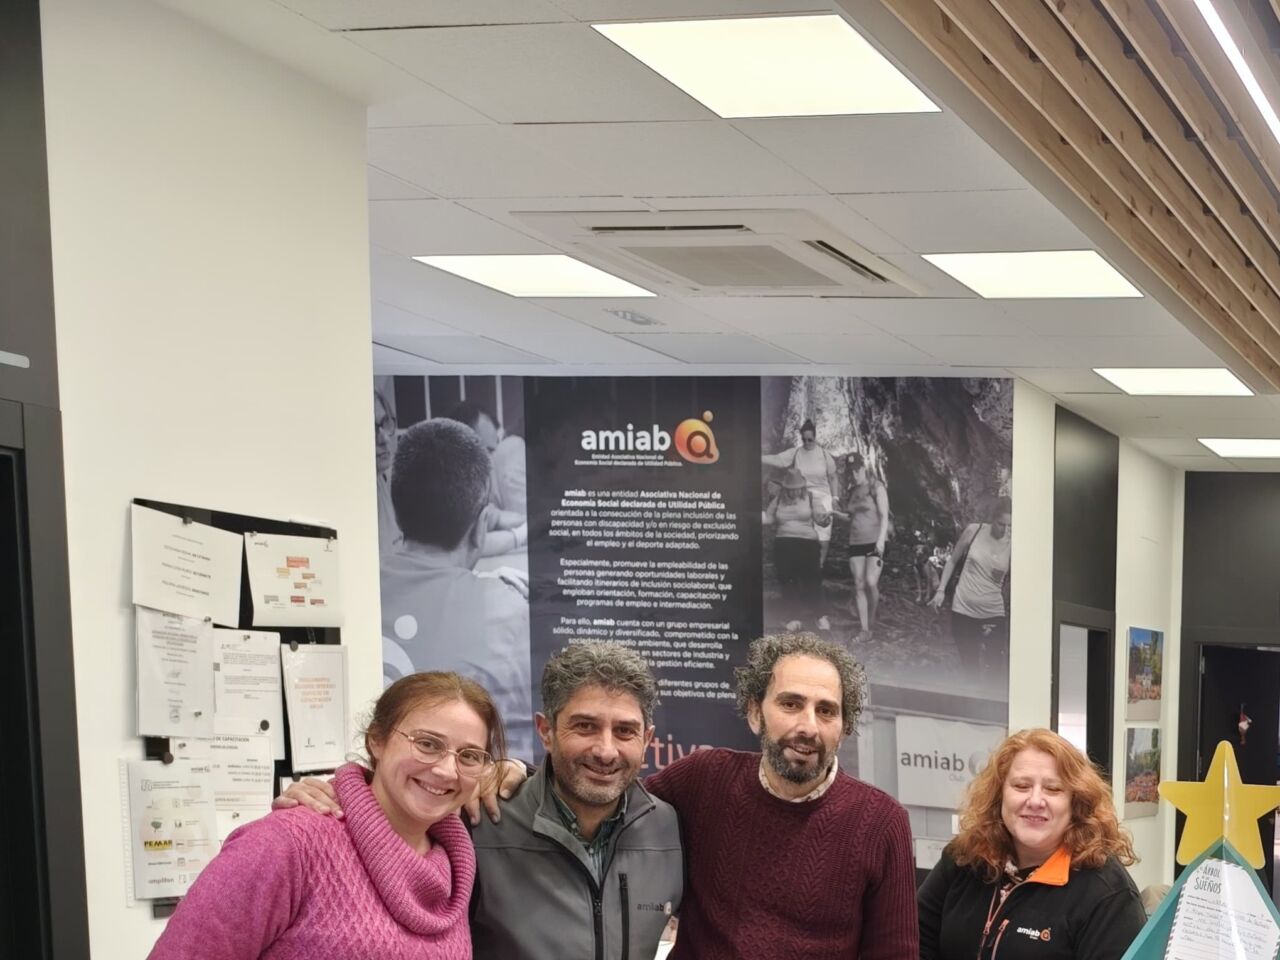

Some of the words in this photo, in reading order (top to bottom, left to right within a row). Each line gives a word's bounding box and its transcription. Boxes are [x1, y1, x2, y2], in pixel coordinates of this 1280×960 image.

[581, 423, 671, 451] amiab
[565, 488, 586, 496] amiab
[612, 489, 638, 497] entidad
[678, 490, 710, 498] Nacional
[562, 498, 596, 506] Economía
[597, 499, 619, 507] Social
[668, 500, 696, 508] Utilidad
[698, 500, 725, 508] Pública
[662, 510, 681, 520] plena
[726, 511, 736, 519] las
[552, 520, 582, 528] personas
[646, 520, 657, 530] y/o
[669, 520, 691, 530] riesgo
[549, 528, 570, 538] social,
[582, 528, 602, 536] todos
[603, 529, 613, 537] los
[615, 529, 643, 537] ámbitos
[594, 538, 620, 549] empleo
[636, 539, 663, 550] deporte
[612, 561, 648, 569] promueve
[718, 561, 728, 569] las
[564, 570, 595, 578] personas
[563, 587, 595, 598] engloban
[717, 584, 732, 592] que
[625, 599, 652, 609] empleo
[561, 616, 576, 624] Para
[578, 617, 591, 627] ello,
[593, 617, 615, 626] amiab
[616, 618, 640, 626] cuenta
[666, 622, 687, 630] grupo
[553, 626, 575, 636] sólido,
[576, 626, 608, 635] dinámico
[901, 750, 965, 772] amiab
[1194, 876, 1222, 894] SUEÑOS
[1016, 926, 1040, 937] amiab
